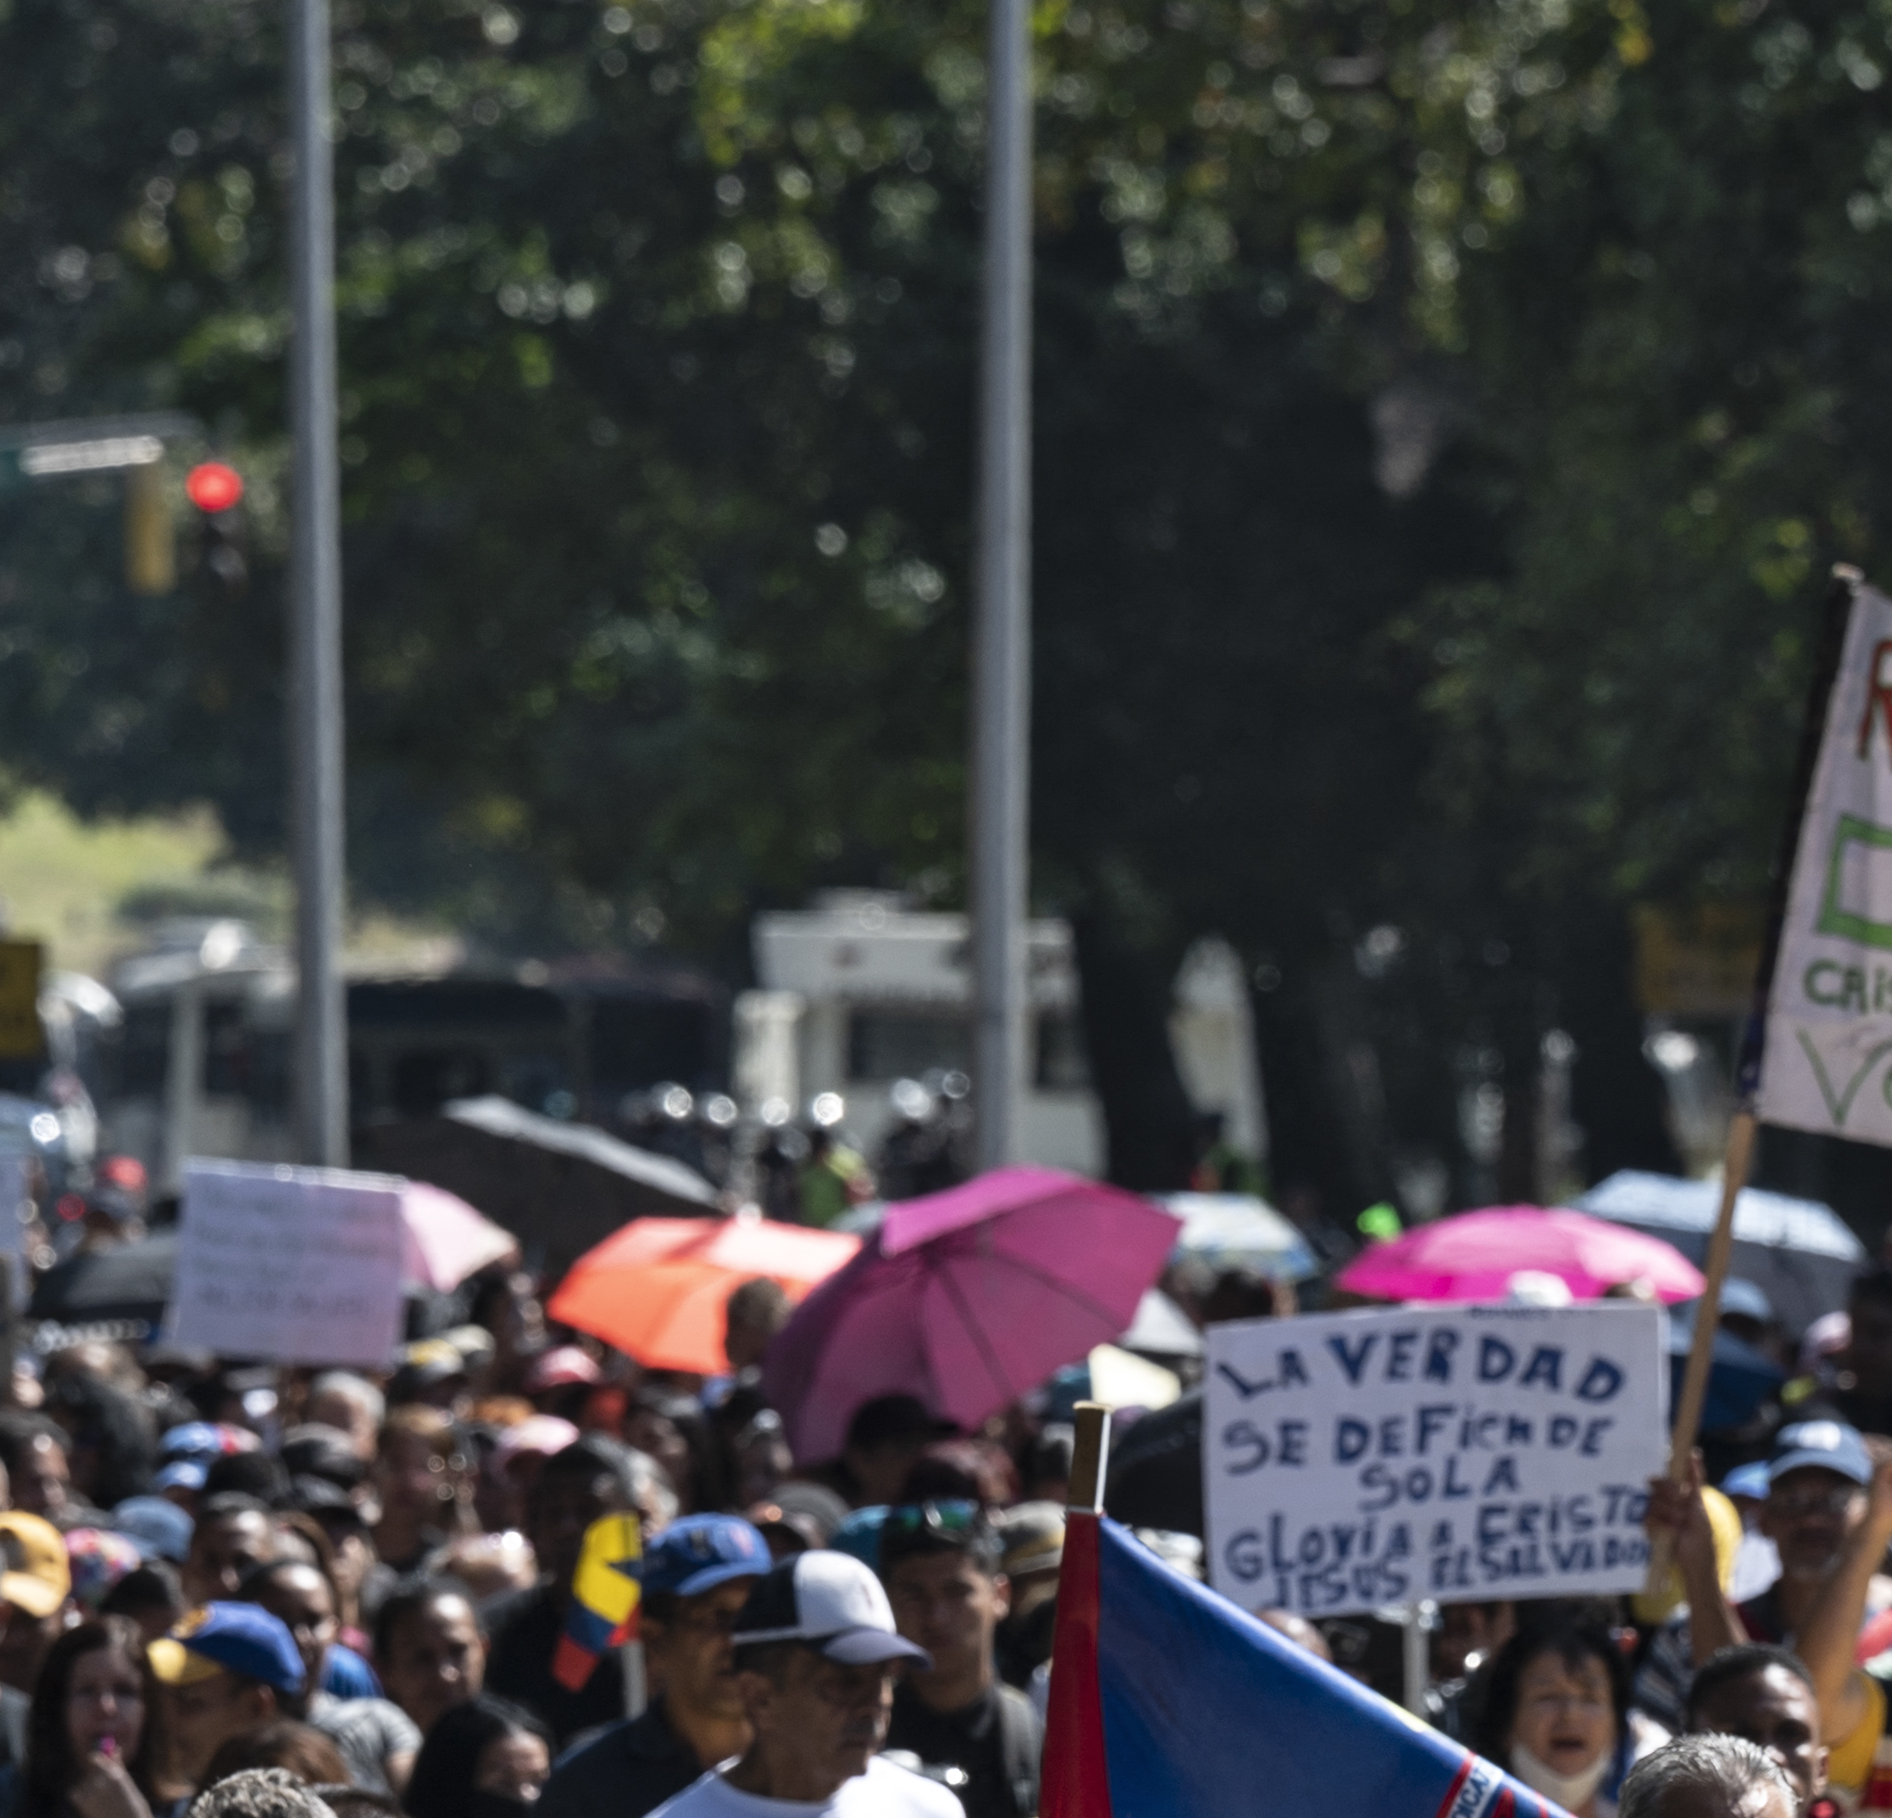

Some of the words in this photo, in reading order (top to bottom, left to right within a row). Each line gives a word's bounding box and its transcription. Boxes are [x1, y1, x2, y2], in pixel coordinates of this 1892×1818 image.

[1215, 1349, 1311, 1399] LA
[1326, 1326, 1626, 1403] VERDAD
[1222, 1417, 1309, 1476] SE
